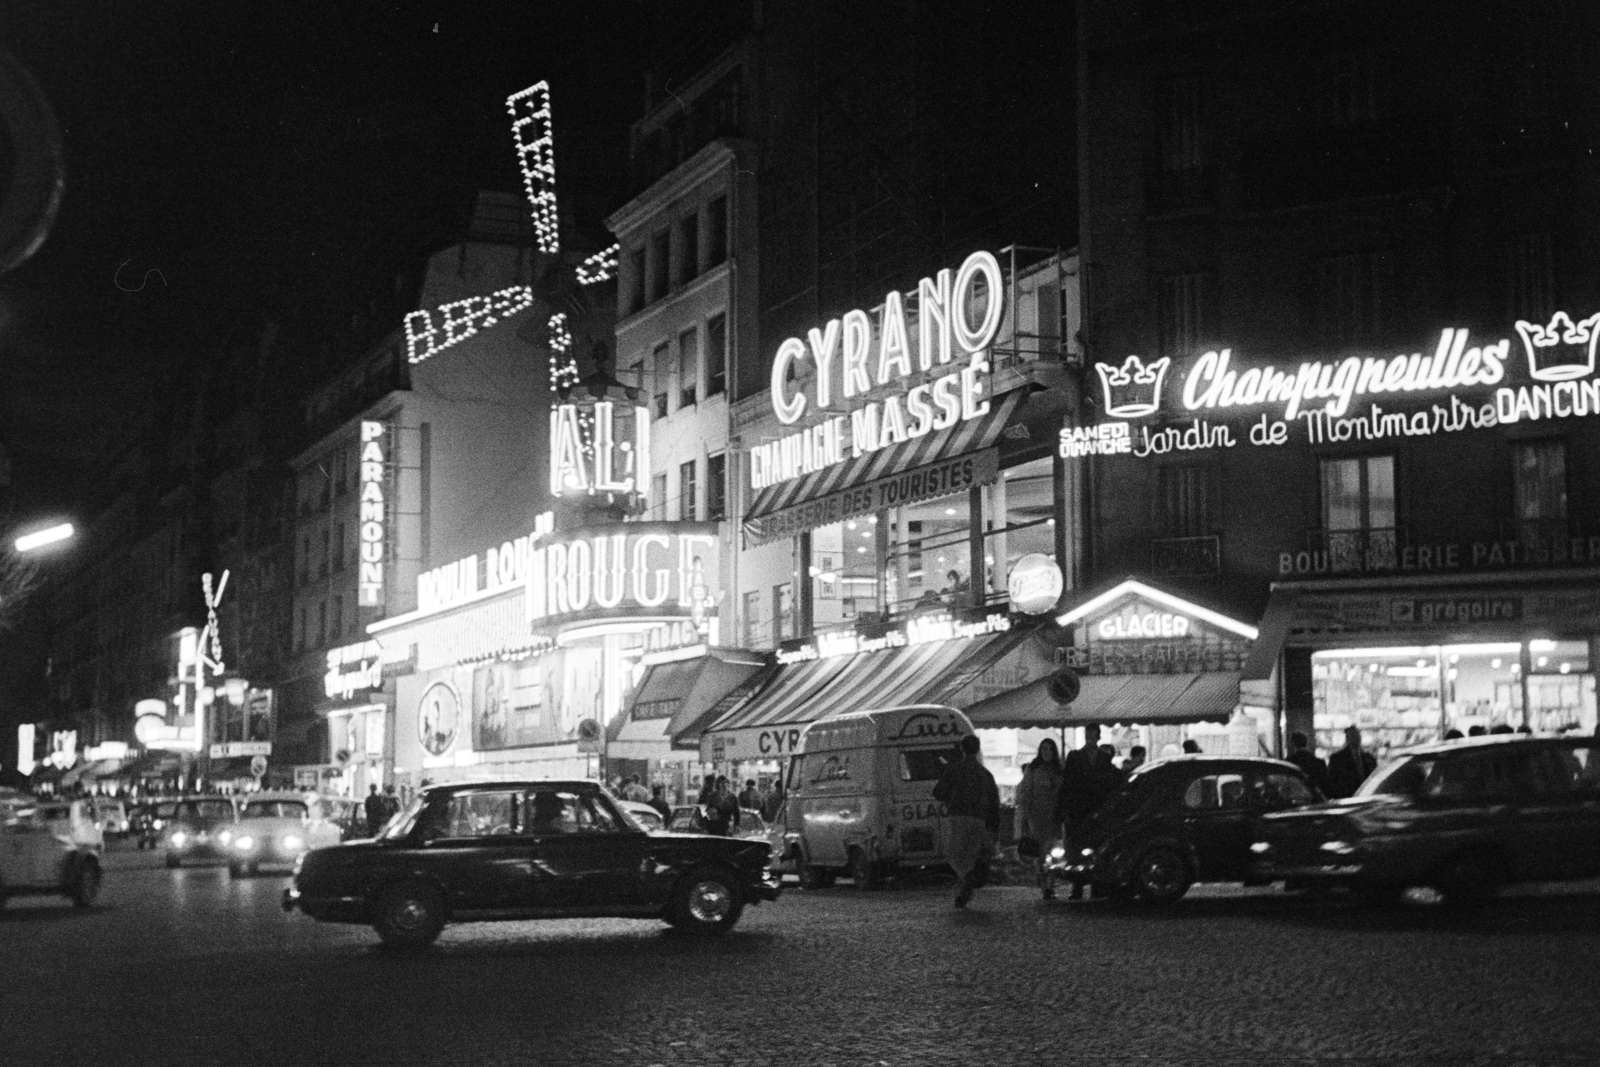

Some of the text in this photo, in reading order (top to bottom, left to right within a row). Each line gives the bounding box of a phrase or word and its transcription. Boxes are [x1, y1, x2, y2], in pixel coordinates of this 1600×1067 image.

[771, 250, 1003, 425] CYRANO
[1183, 328, 1510, 419] Champigneulles
[750, 351, 991, 489] CHAMPAGNE MASSÉ
[1059, 421, 1130, 444] SAMEDI
[1249, 412, 1288, 446] de
[1297, 394, 1498, 445] Montmartre
[360, 420, 385, 603] PARAMOUNT
[842, 486, 873, 514] DES
[879, 458, 974, 507] TOURISTES
[417, 553, 478, 613] MOULIN
[547, 533, 714, 617] ROUGE
[1278, 543, 1460, 575] BOUNERIE
[643, 620, 697, 655] TABAC
[1098, 613, 1190, 638] GLACIER
[758, 728, 801, 755] CYR
